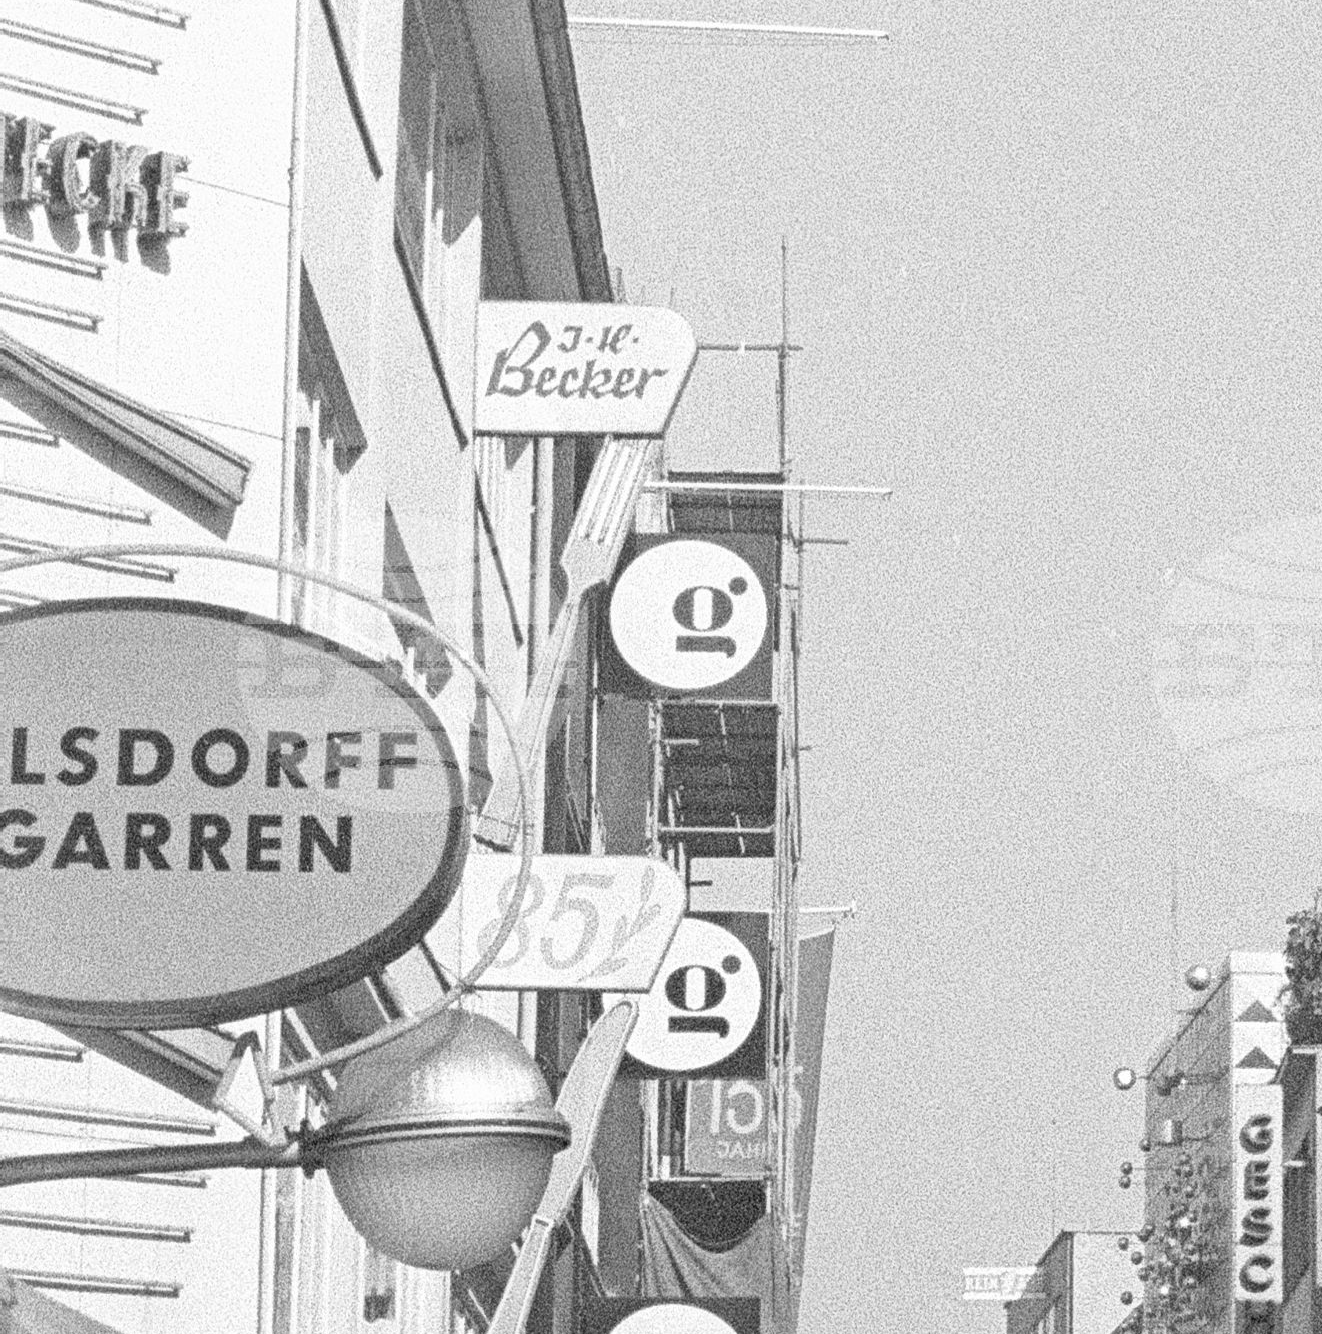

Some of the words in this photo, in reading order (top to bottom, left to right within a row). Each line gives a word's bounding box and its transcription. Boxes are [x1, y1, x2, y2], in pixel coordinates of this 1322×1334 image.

[485, 319, 668, 401] Becker
[10, 726, 420, 792] LSDORFF
[0, 808, 354, 873] GARREN
[476, 872, 617, 970] 85
